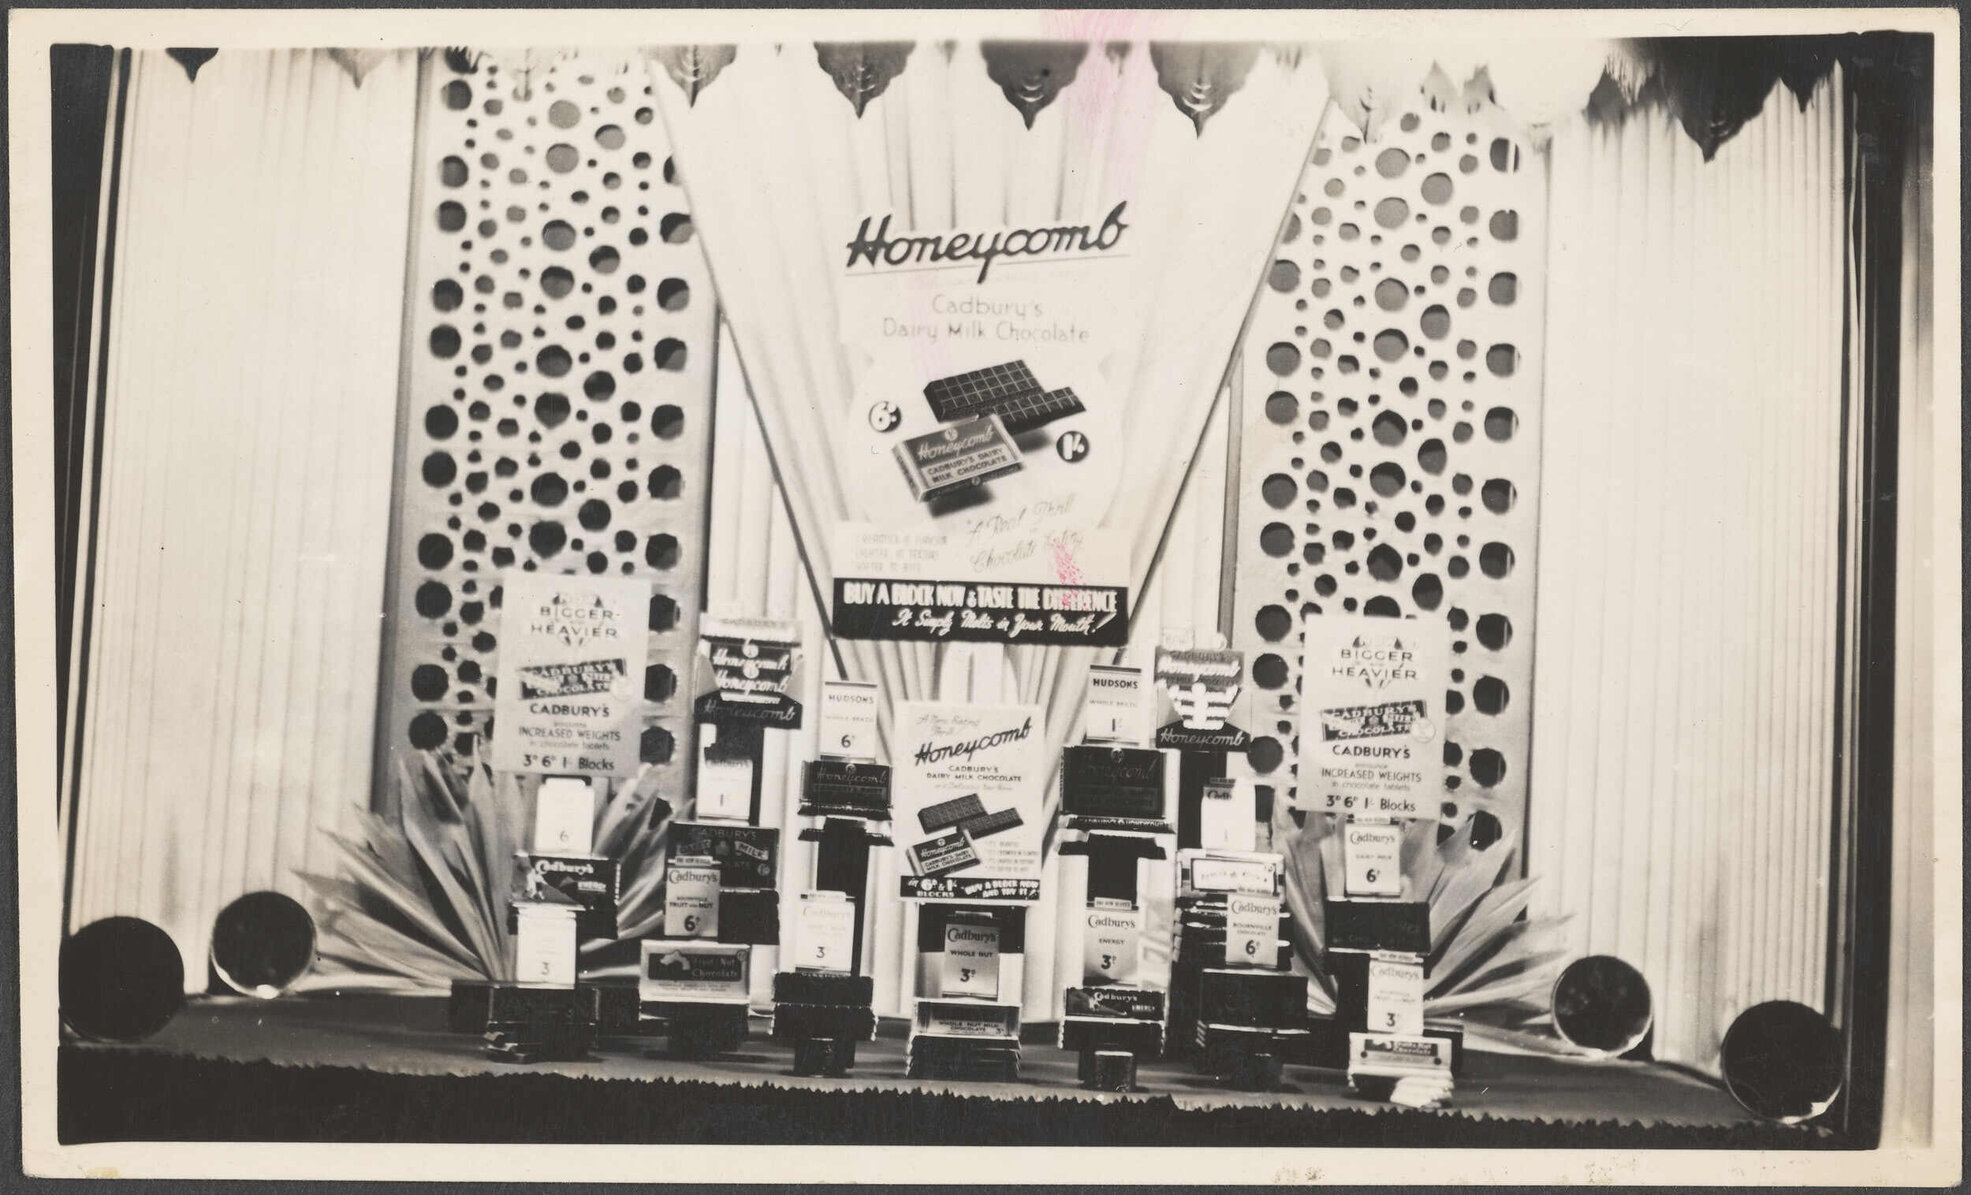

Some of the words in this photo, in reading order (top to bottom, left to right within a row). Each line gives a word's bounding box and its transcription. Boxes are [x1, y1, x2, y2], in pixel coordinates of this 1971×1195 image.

[846, 200, 1130, 284] Honeycomb
[931, 294, 1043, 319] Cadbury's
[883, 318, 938, 343] Dairy
[948, 321, 986, 339] Milk
[996, 322, 1091, 343] Chocolate
[917, 425, 995, 461] Honeycomb
[957, 454, 1008, 476] CHOCOLATE
[843, 582, 875, 605] BUY
[876, 583, 890, 605] A
[892, 583, 935, 606] BLOCK
[936, 585, 967, 607] NOW
[977, 586, 1014, 609] TASTE
[1018, 587, 1041, 610] THE
[915, 609, 954, 637] Simply
[960, 609, 993, 630] Melts
[996, 617, 1009, 632] in
[1008, 613, 1043, 638] Your
[531, 624, 618, 639] HEAVIER
[1341, 650, 1413, 662] BIGGER
[1332, 666, 1418, 680] HEAVIER
[1092, 678, 1139, 689] HUDSONS
[828, 694, 874, 704] HUDSONS
[529, 703, 610, 718] CADBURY'S
[518, 726, 572, 739] INCREASED
[577, 729, 621, 741] WEIGHTS
[1160, 727, 1244, 746] Honeycomb
[914, 716, 1033, 767] Honeycomb
[1332, 744, 1410, 759] CADBURY'S
[578, 757, 614, 770] Blocks
[948, 765, 999, 773] CADBURY'S
[977, 774, 1022, 782] CHOCOLATE
[1322, 768, 1374, 780] INCREASED
[1379, 770, 1422, 783] WEIGHTS
[1380, 797, 1416, 812] Blocks
[1350, 831, 1396, 845] Cadbury's
[921, 837, 965, 859] Honeycomb
[668, 869, 718, 885] Cadbury's
[1019, 880, 1039, 889] NOW
[916, 890, 954, 898] BLOCKS
[982, 889, 999, 898] AND
[669, 901, 688, 909] FRUIT
[698, 902, 714, 910] NUT
[1231, 899, 1278, 915] Cadbury's
[1087, 914, 1136, 930] Cadbury's
[947, 927, 997, 943] Cadbury's
[950, 950, 976, 958] WHOLE
